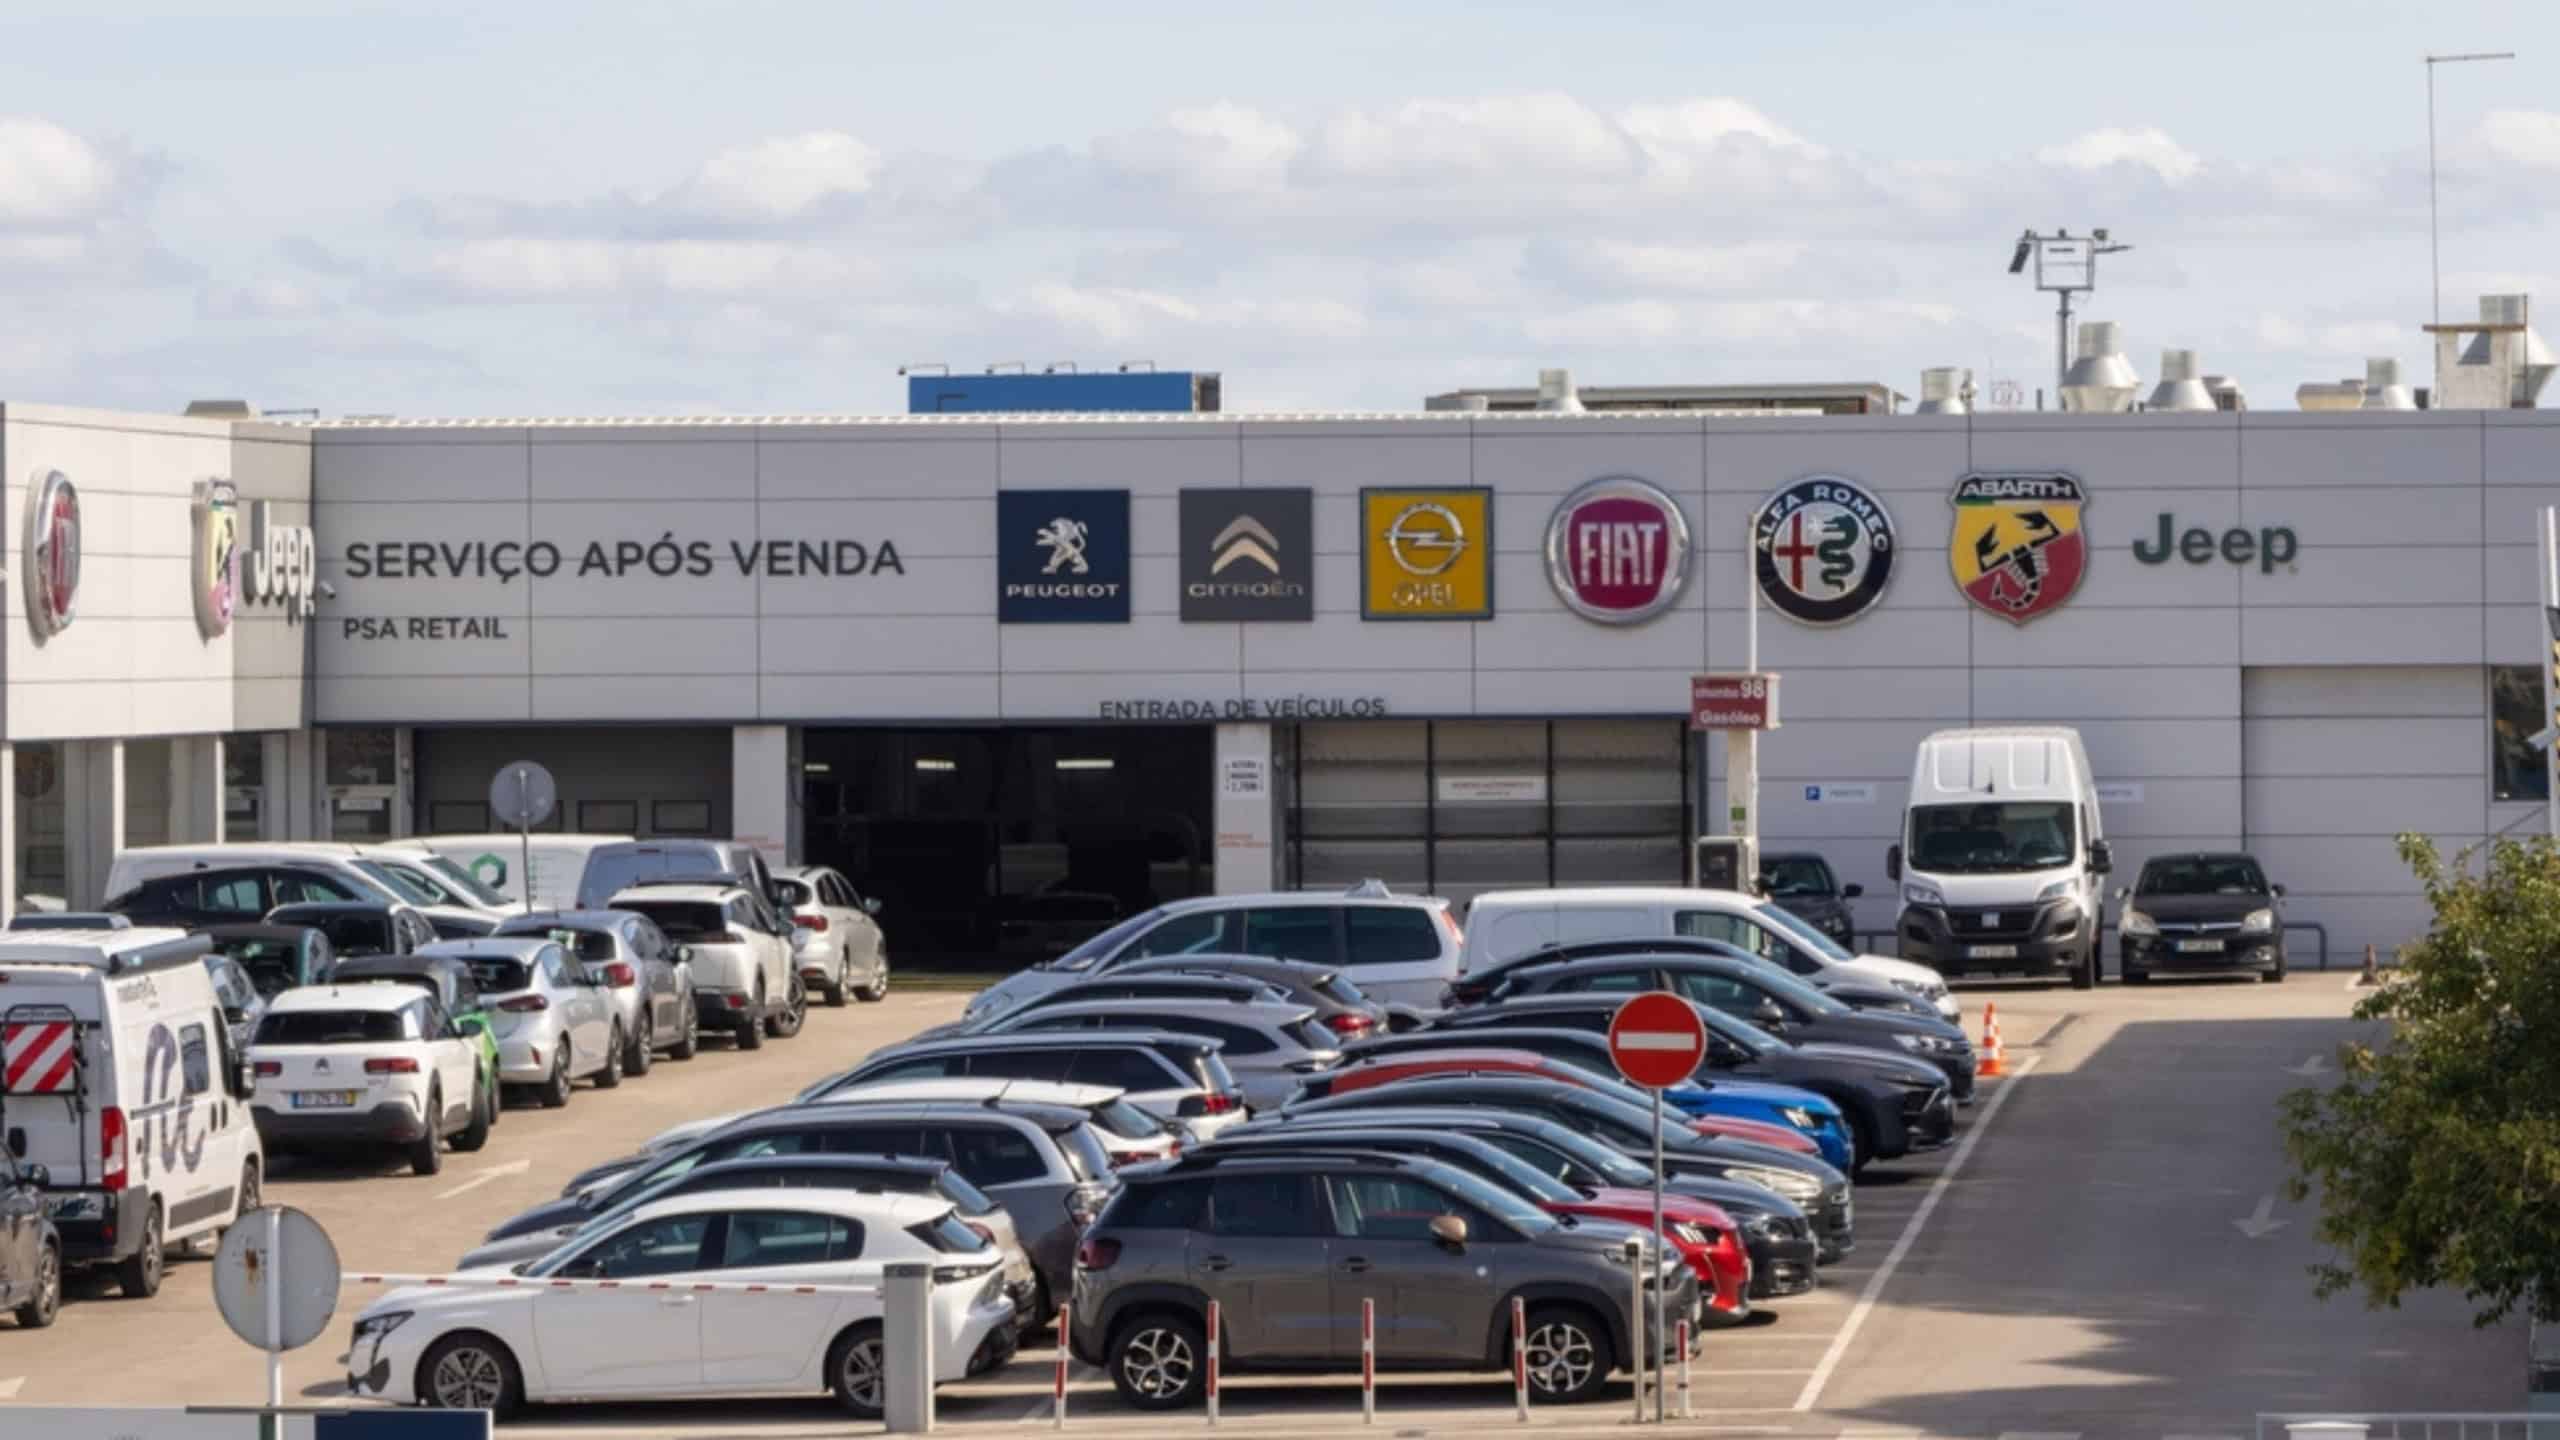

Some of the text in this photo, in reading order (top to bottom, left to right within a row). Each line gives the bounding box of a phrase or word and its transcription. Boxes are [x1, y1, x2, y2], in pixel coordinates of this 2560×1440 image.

[1962, 480, 2072, 497] ABARTH
[1757, 484, 1889, 552] ALFA ROMEO
[345, 531, 905, 584] SERVIÇO APÓS VENDA
[1580, 521, 1662, 586] FIAT
[2132, 513, 2297, 575] Jeep
[253, 499, 315, 617] Jeep
[1006, 582, 1120, 598] PEUGEOT
[1391, 582, 1456, 607] OPEL
[343, 616, 508, 640] PSA RETAIL
[1740, 679, 1765, 699] 98
[1098, 693, 1386, 720] ENTRADA DE VEÍCULOS
